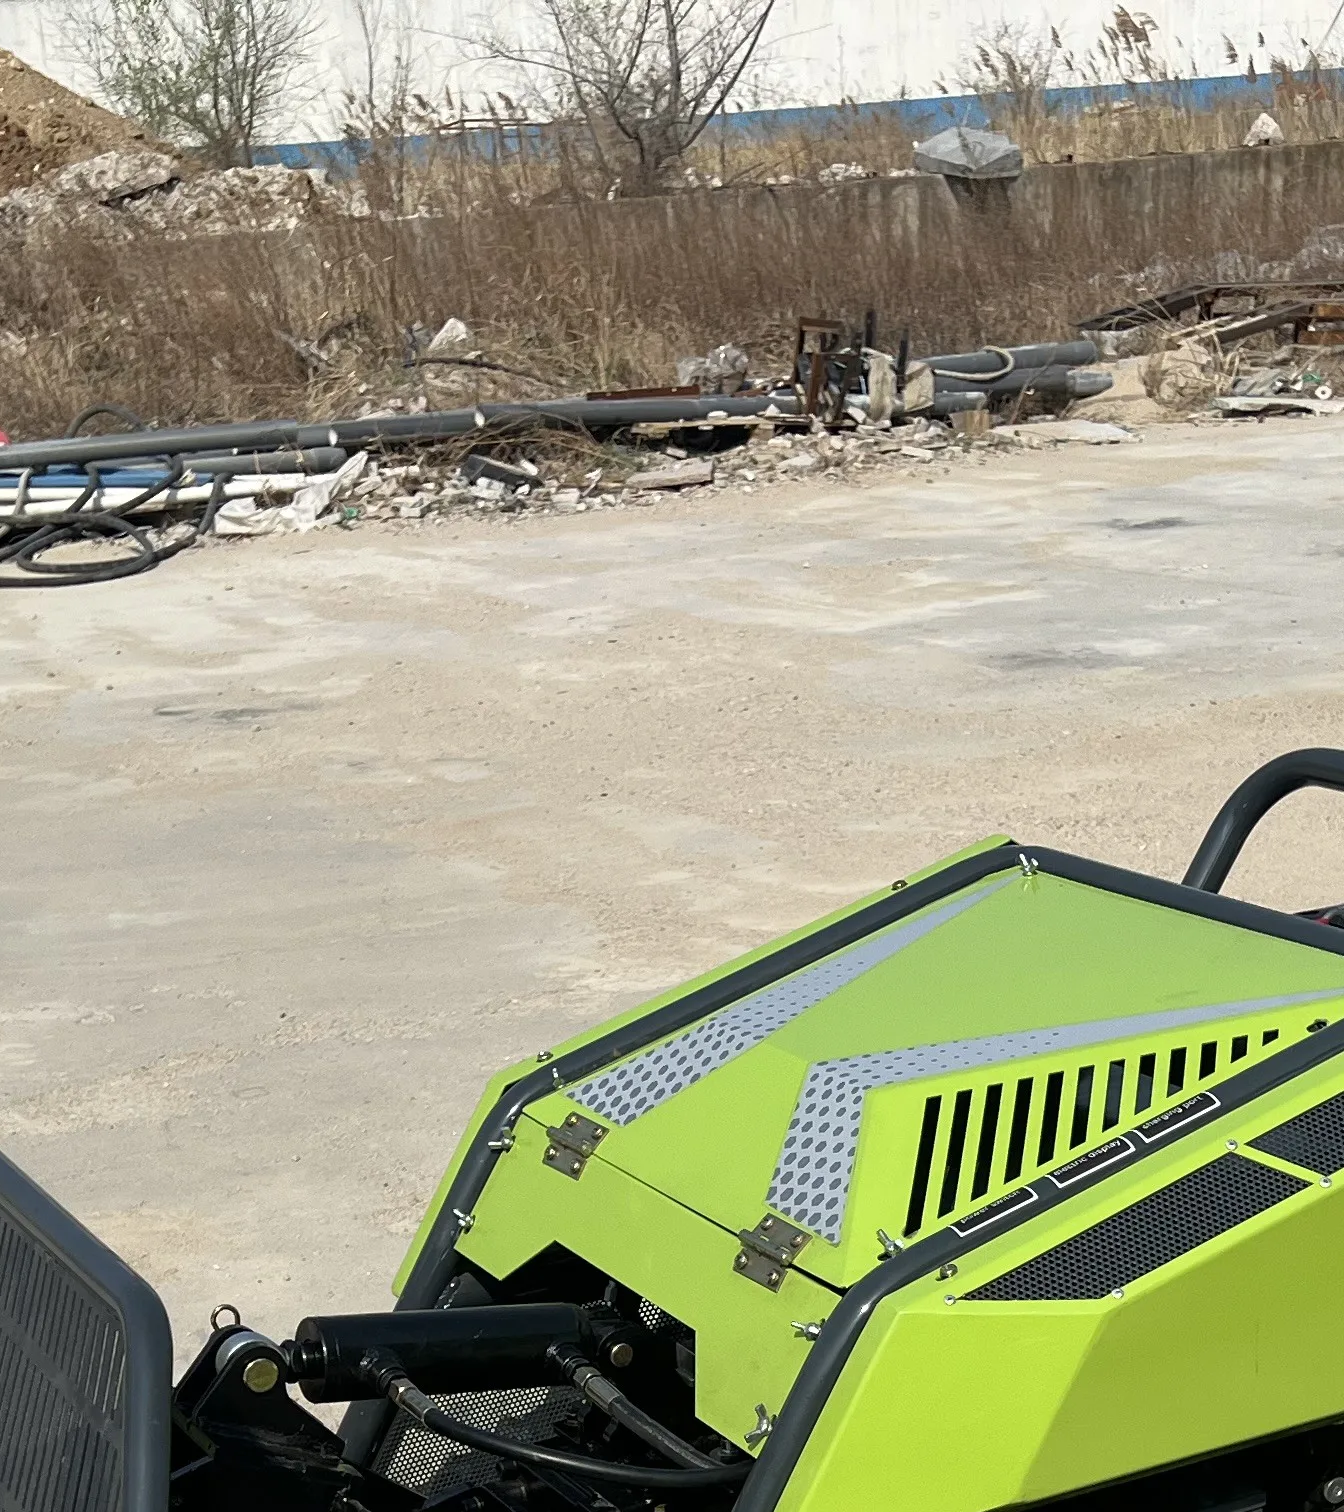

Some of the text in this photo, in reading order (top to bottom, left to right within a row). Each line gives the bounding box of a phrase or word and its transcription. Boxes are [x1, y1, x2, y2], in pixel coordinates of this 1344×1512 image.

[1142, 1095, 1204, 1129] charging port
[1053, 1140, 1121, 1176] electric display
